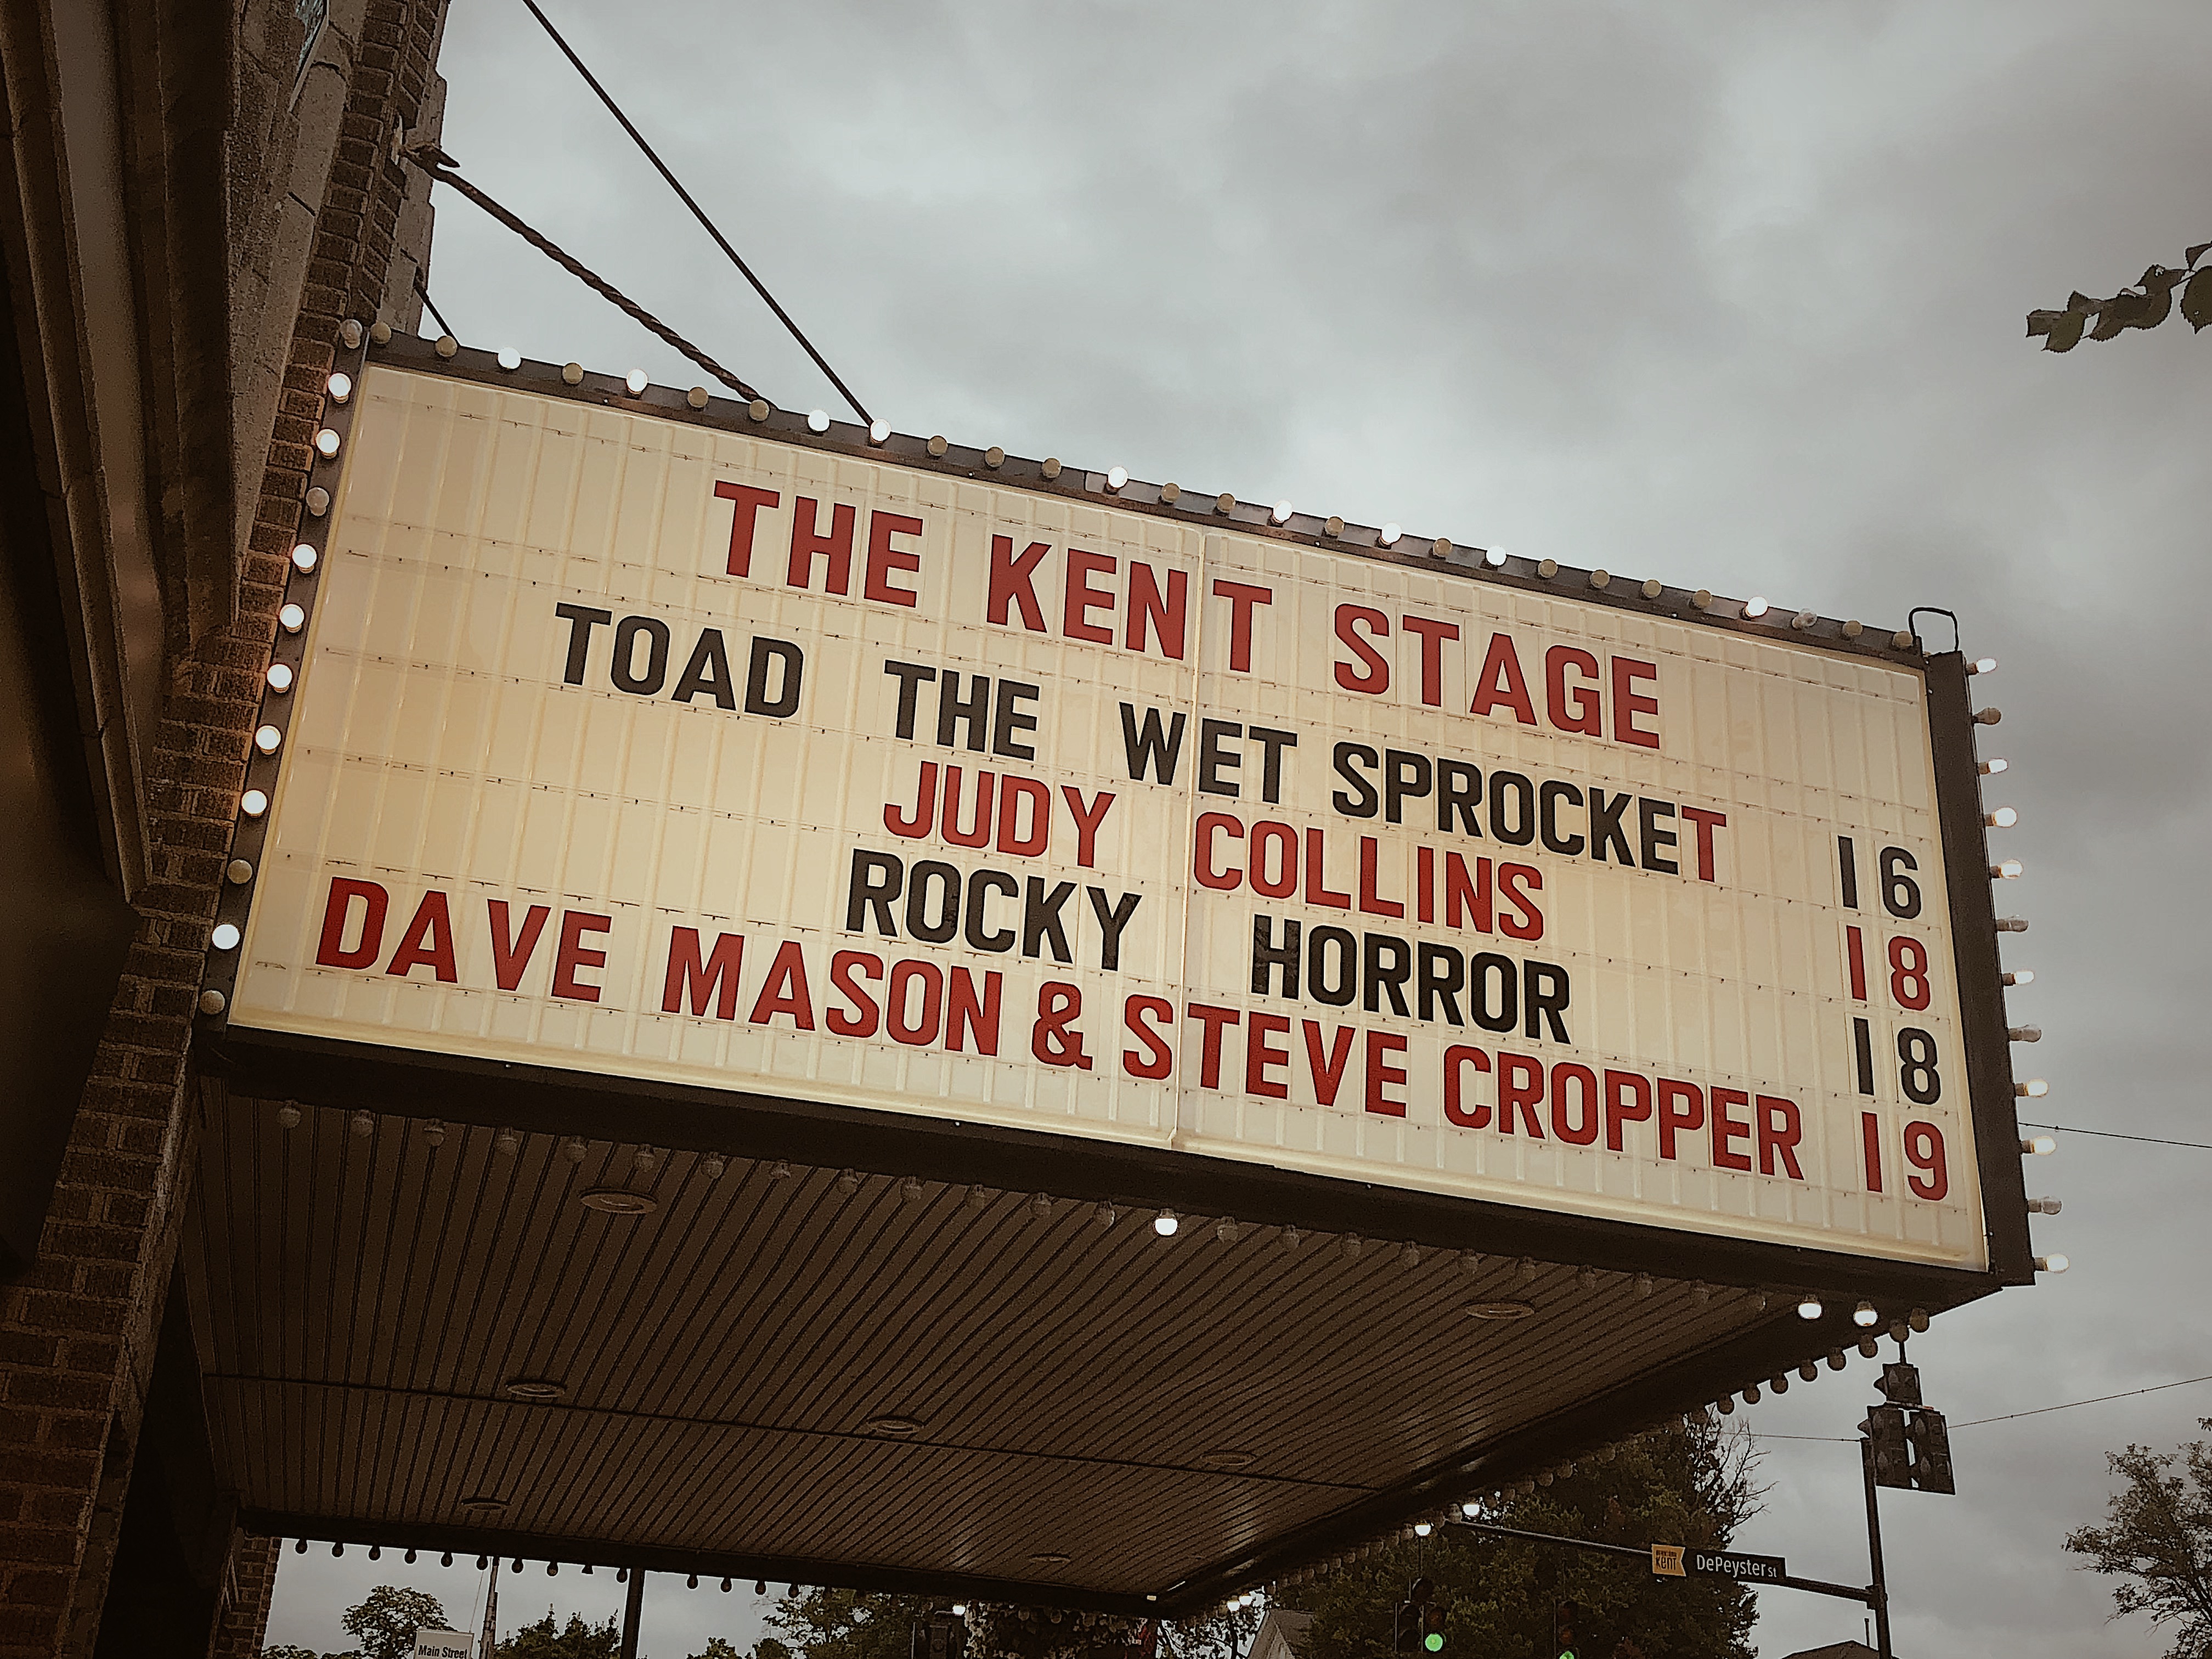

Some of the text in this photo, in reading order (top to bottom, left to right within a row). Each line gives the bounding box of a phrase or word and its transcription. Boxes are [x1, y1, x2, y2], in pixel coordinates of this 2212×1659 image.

[714, 479, 1660, 749] THE KENT STAGE
[555, 602, 1922, 919] TOAD THE WET SPROCKET 16
[883, 760, 1932, 1011] JUDY COLLINS 18
[315, 876, 1949, 1201] DAVE MASON & STEVE CROPPER 19
[845, 848, 1941, 1105] ROCKY HORROR 18
[418, 1645, 467, 1659] Main Street
[1696, 1554, 1767, 1578] DePeyster
